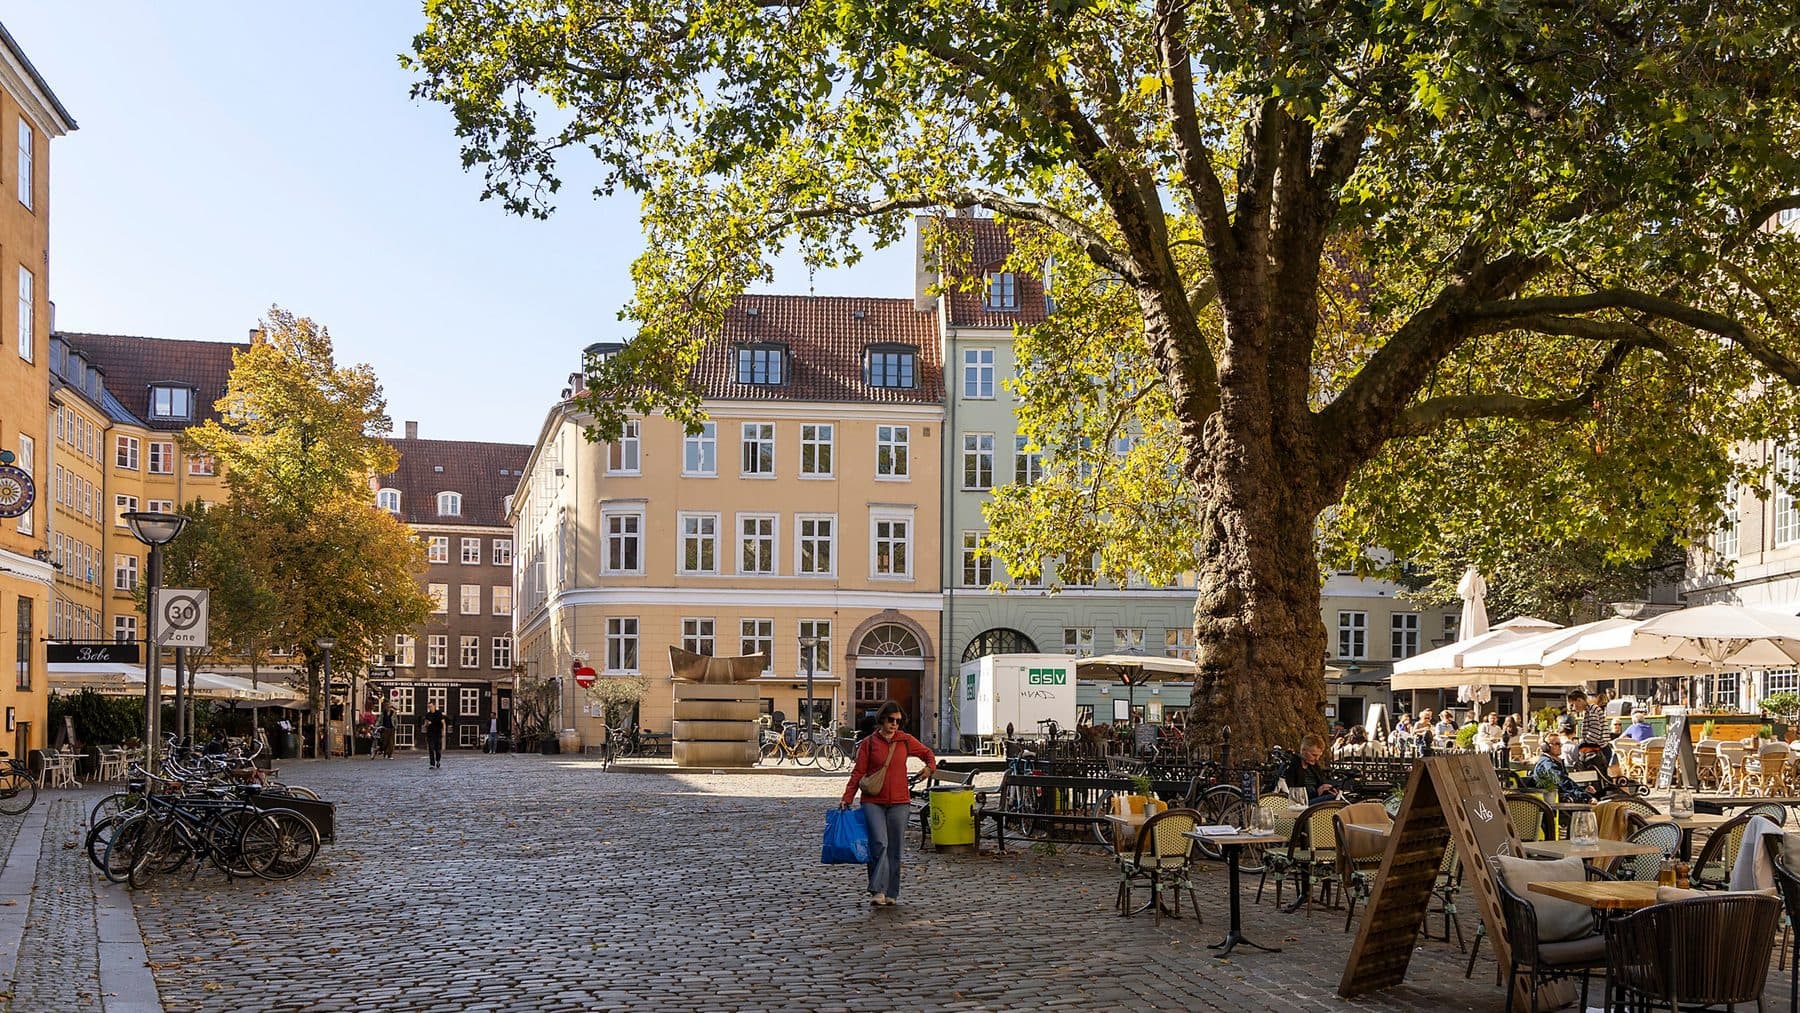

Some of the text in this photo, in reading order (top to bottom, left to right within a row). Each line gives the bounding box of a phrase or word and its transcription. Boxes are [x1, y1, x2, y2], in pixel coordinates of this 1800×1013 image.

[171, 606, 194, 619] 30
[169, 632, 195, 641] Zone
[1030, 673, 1065, 684] GSV
